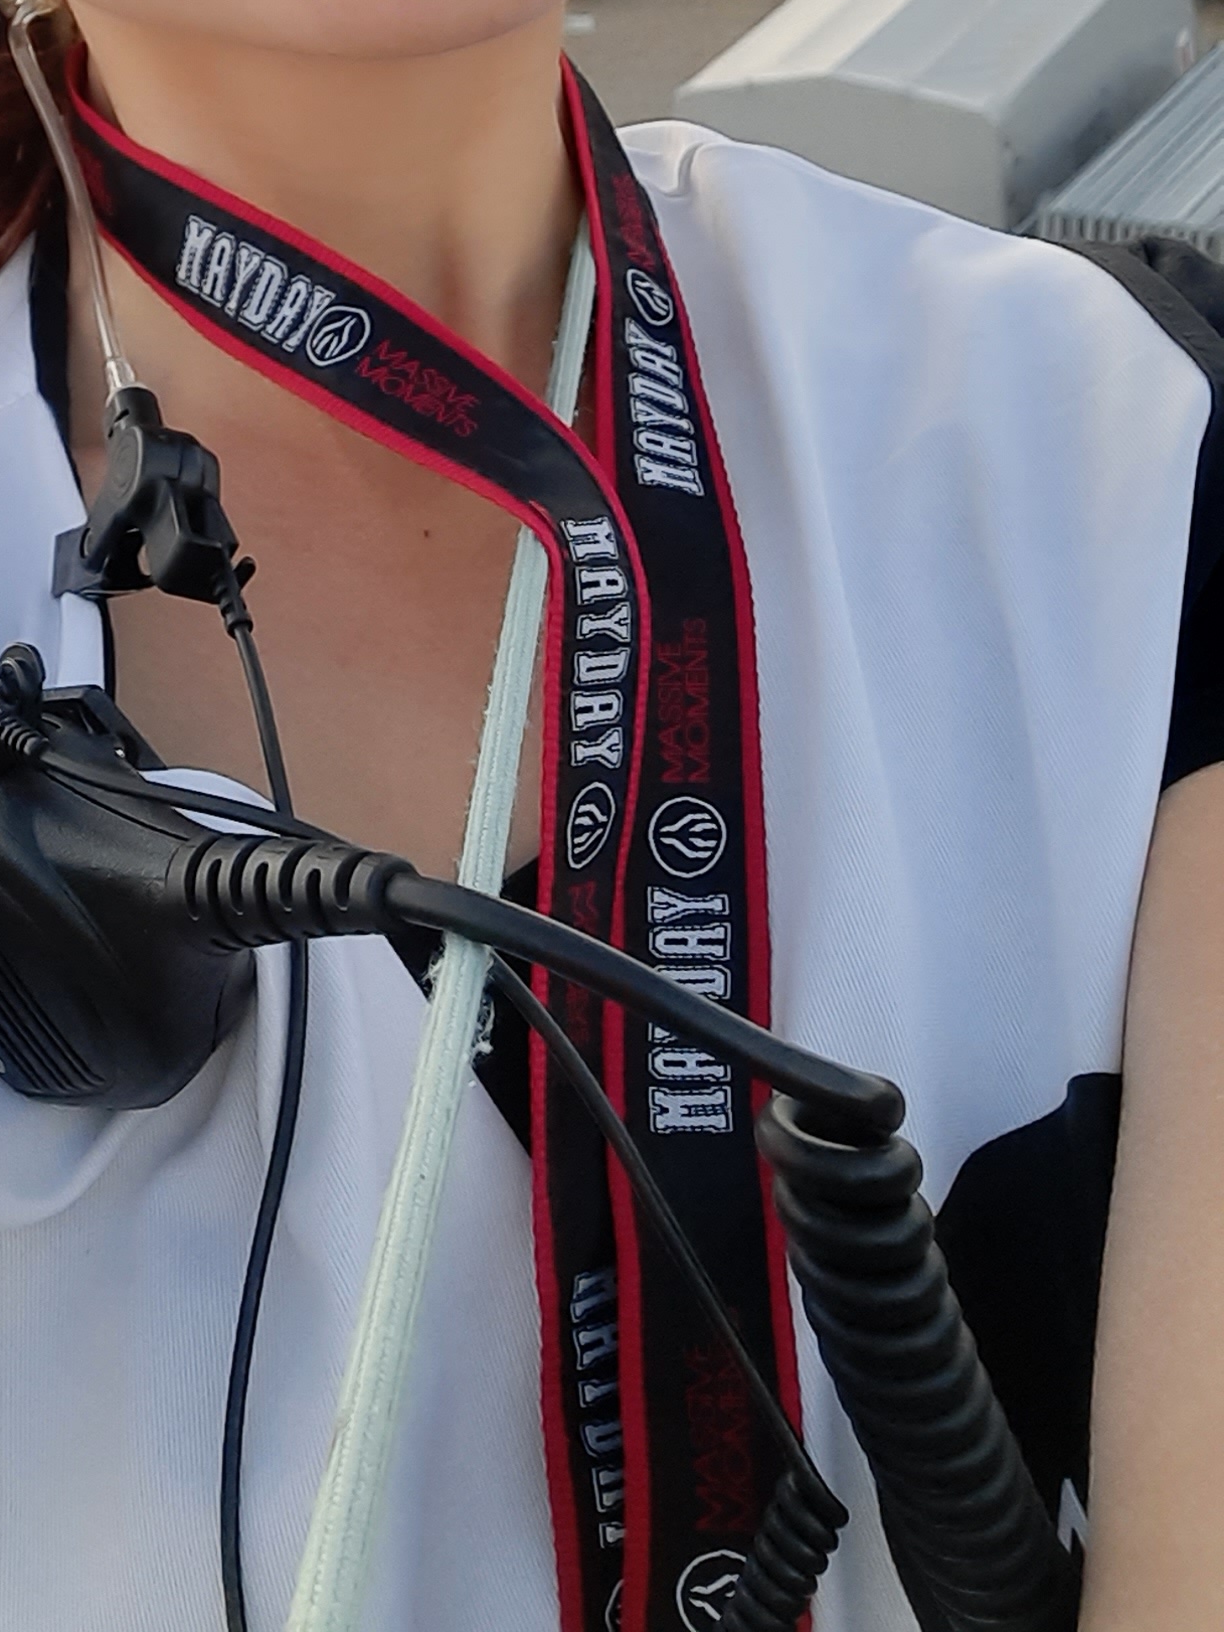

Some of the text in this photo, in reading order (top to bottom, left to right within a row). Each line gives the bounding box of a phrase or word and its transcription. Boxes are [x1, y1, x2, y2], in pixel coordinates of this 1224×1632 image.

[176, 214, 336, 353] MAYDAY
[354, 357, 478, 437] MOMENTS
[374, 340, 479, 411] MASSIVE
[625, 318, 704, 497] MAYDAY
[560, 516, 632, 770] MAYDAY
[656, 642, 683, 785] MASSIVE
[682, 617, 711, 785] MOMENTS
